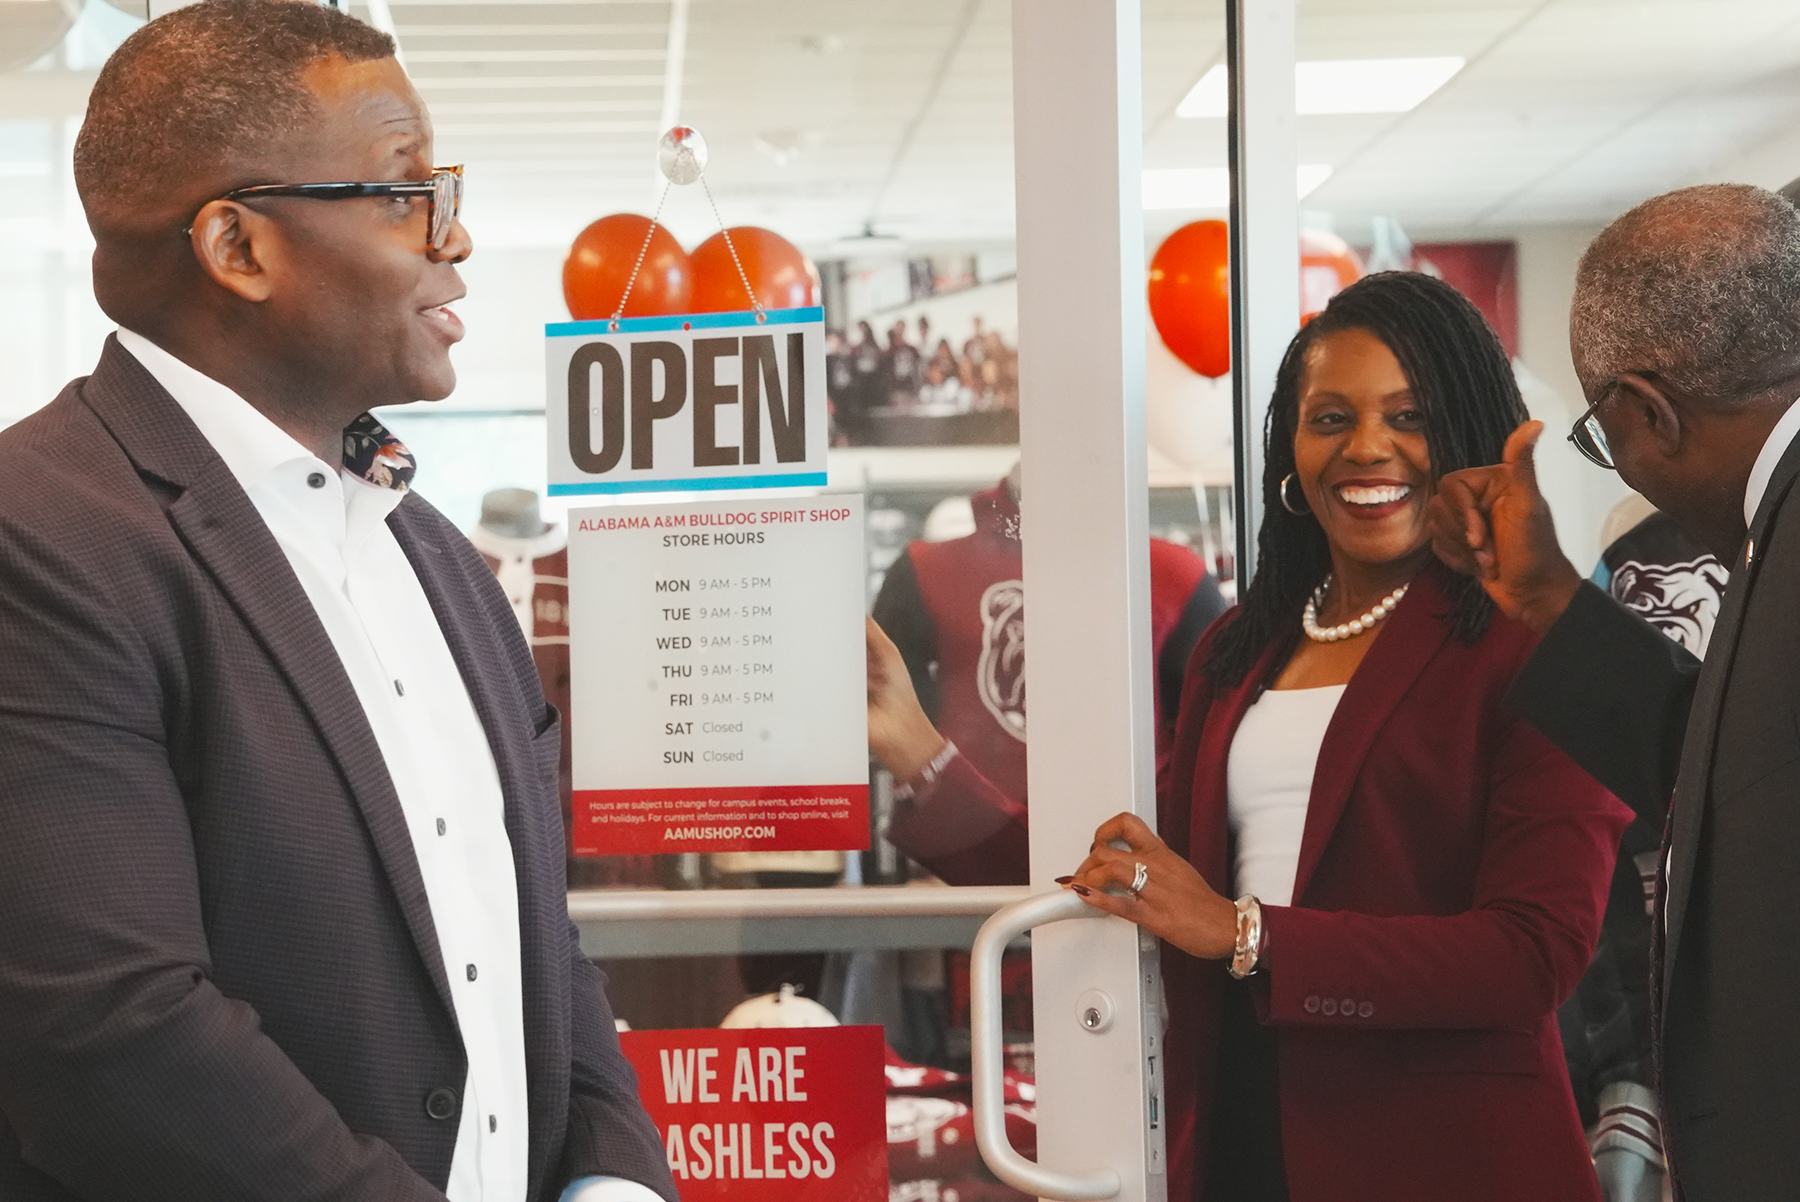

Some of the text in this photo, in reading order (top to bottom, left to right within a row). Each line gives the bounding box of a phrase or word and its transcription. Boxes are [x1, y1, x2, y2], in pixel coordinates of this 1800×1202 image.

[568, 332, 806, 474] OPEN
[578, 508, 851, 531] ALABAMA A&M BULLDOG SPIRIT SHOP
[663, 531, 765, 547] STORE HOURS
[655, 579, 690, 593] MON
[699, 578, 707, 590] 9
[709, 578, 730, 589] AM
[740, 577, 748, 589] 5
[751, 577, 771, 588] PM
[662, 607, 691, 621] TUE
[699, 607, 708, 619] 9
[710, 607, 731, 618] AM
[741, 606, 749, 618] 5
[752, 606, 772, 617] PM
[656, 636, 692, 650] WED
[700, 636, 708, 648] 9
[711, 636, 731, 647] AM
[742, 635, 750, 646] 5
[752, 634, 773, 645] PM
[662, 665, 692, 678] THU
[700, 664, 709, 676] 9
[711, 664, 732, 675] AM
[742, 663, 750, 675] 5
[753, 663, 773, 674] PM
[670, 693, 693, 706] FRI
[701, 693, 709, 705] 9
[712, 693, 732, 704] AM
[743, 692, 751, 704] 5
[754, 692, 774, 703] PM
[665, 721, 743, 736] SAT Closed
[663, 750, 744, 764] SUN Closed
[589, 796, 851, 811] Hours are subject to change for campus events, school breaks,
[591, 810, 849, 824] and holidays. For current information and to shop online, visit
[664, 826, 776, 840] AAMUSHOP.COM
[660, 1046, 807, 1104] WE ARE
[656, 1122, 835, 1180] ASHLESS
